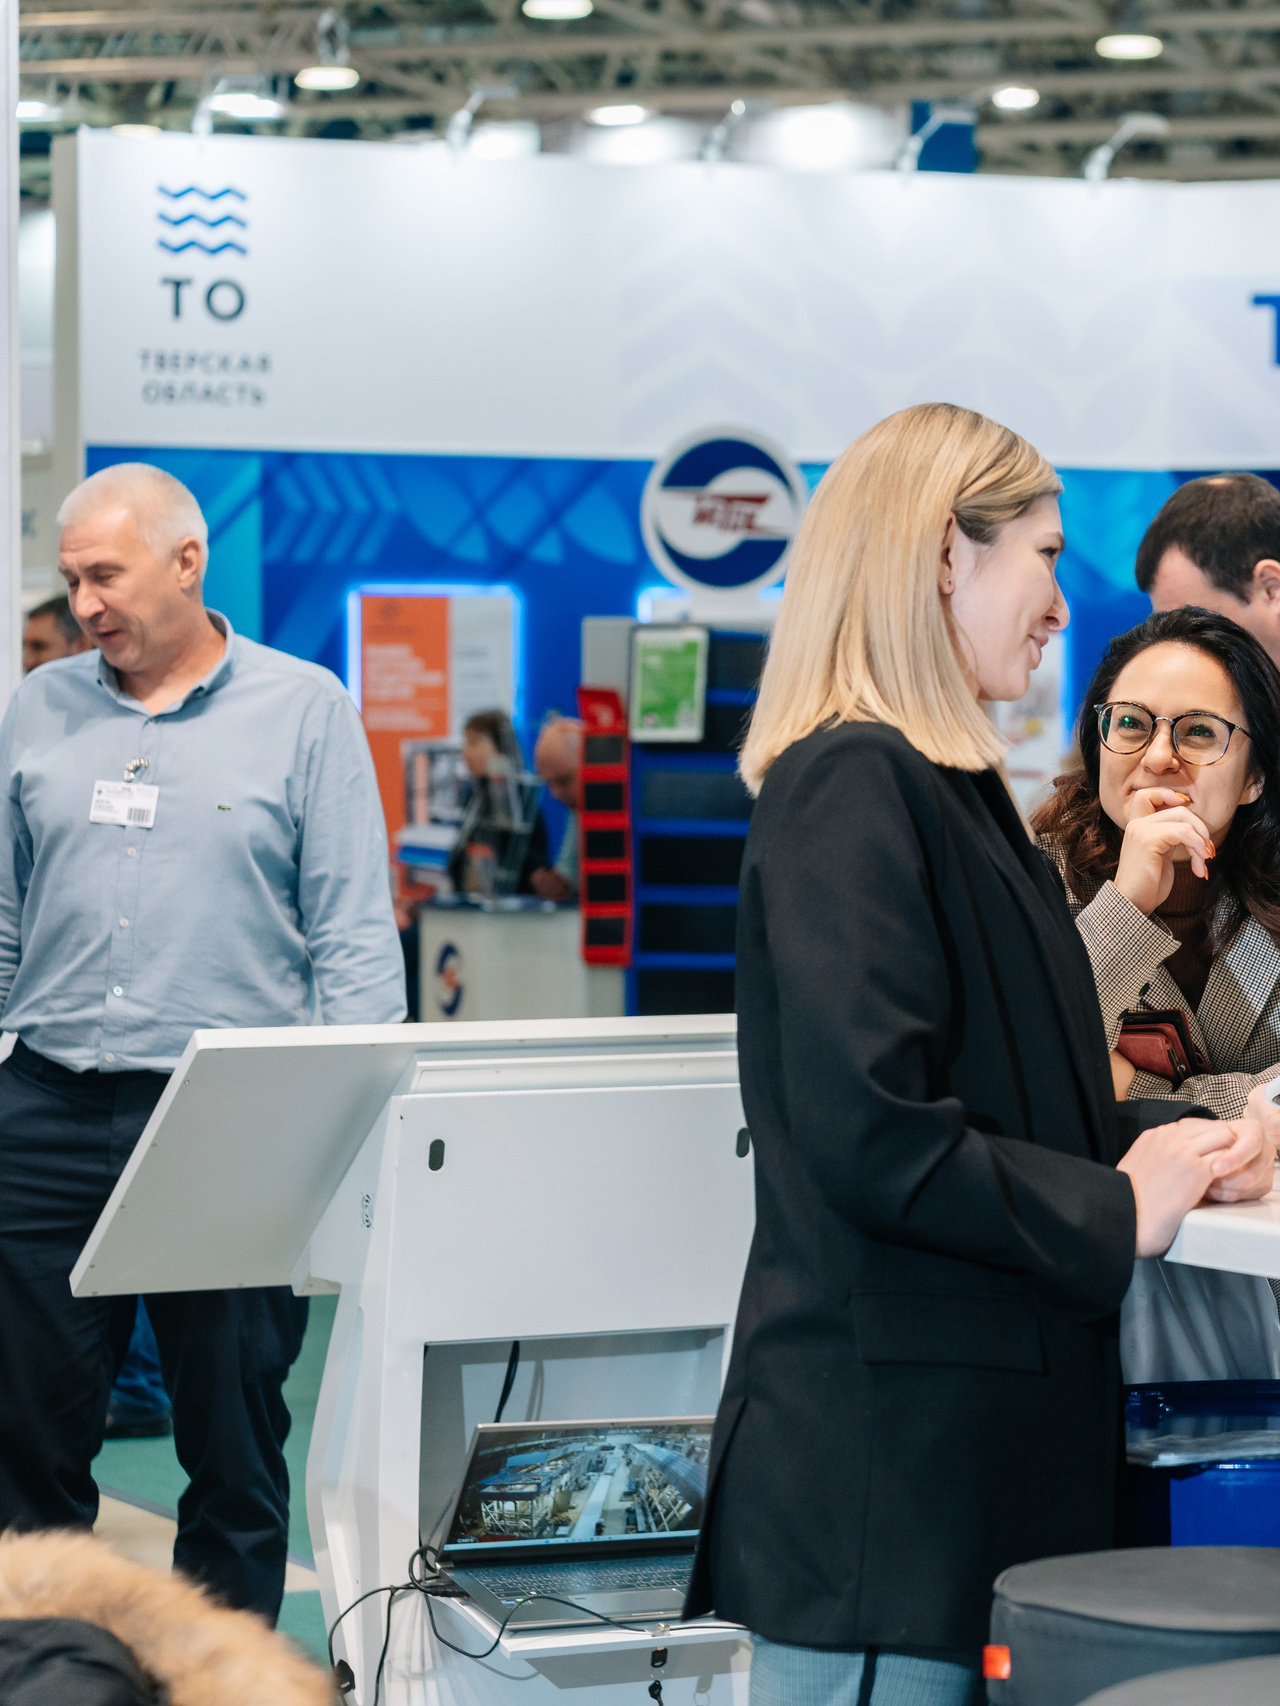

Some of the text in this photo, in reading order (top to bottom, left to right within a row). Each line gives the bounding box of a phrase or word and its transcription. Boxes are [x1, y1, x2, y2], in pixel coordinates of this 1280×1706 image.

[161, 276, 246, 320] ТО
[139, 349, 273, 373] ТВЕРСКАЯ
[142, 380, 266, 406] ОБЛАСТЬ
